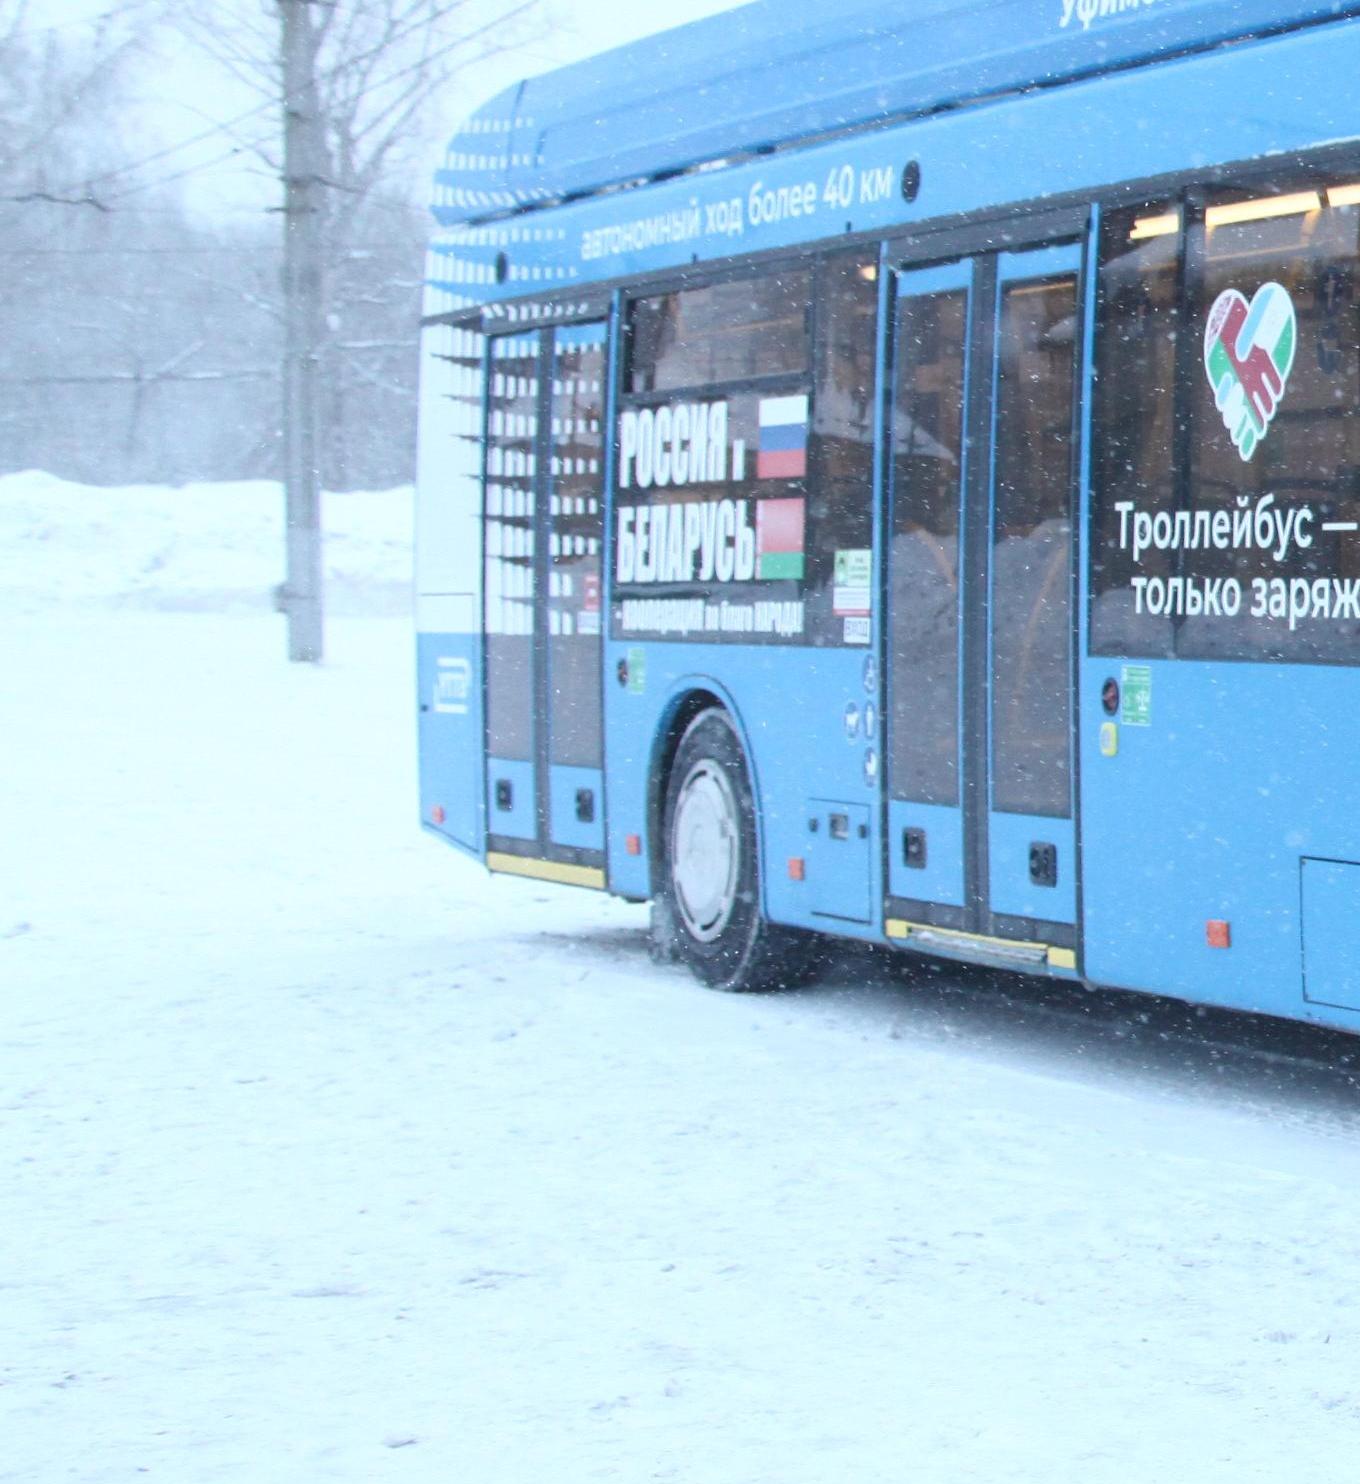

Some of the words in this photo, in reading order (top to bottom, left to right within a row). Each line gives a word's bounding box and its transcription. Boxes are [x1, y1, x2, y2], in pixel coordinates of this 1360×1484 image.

[581, 197, 700, 260] автономный
[705, 197, 744, 236] ход
[748, 180, 817, 226] более
[823, 165, 854, 208] 40
[859, 166, 894, 203] км
[619, 401, 728, 488] РОССИЯ
[616, 499, 756, 583] БЕЛАРУСЬ
[1114, 493, 1314, 562] Троллейбус
[1131, 576, 1241, 617] только
